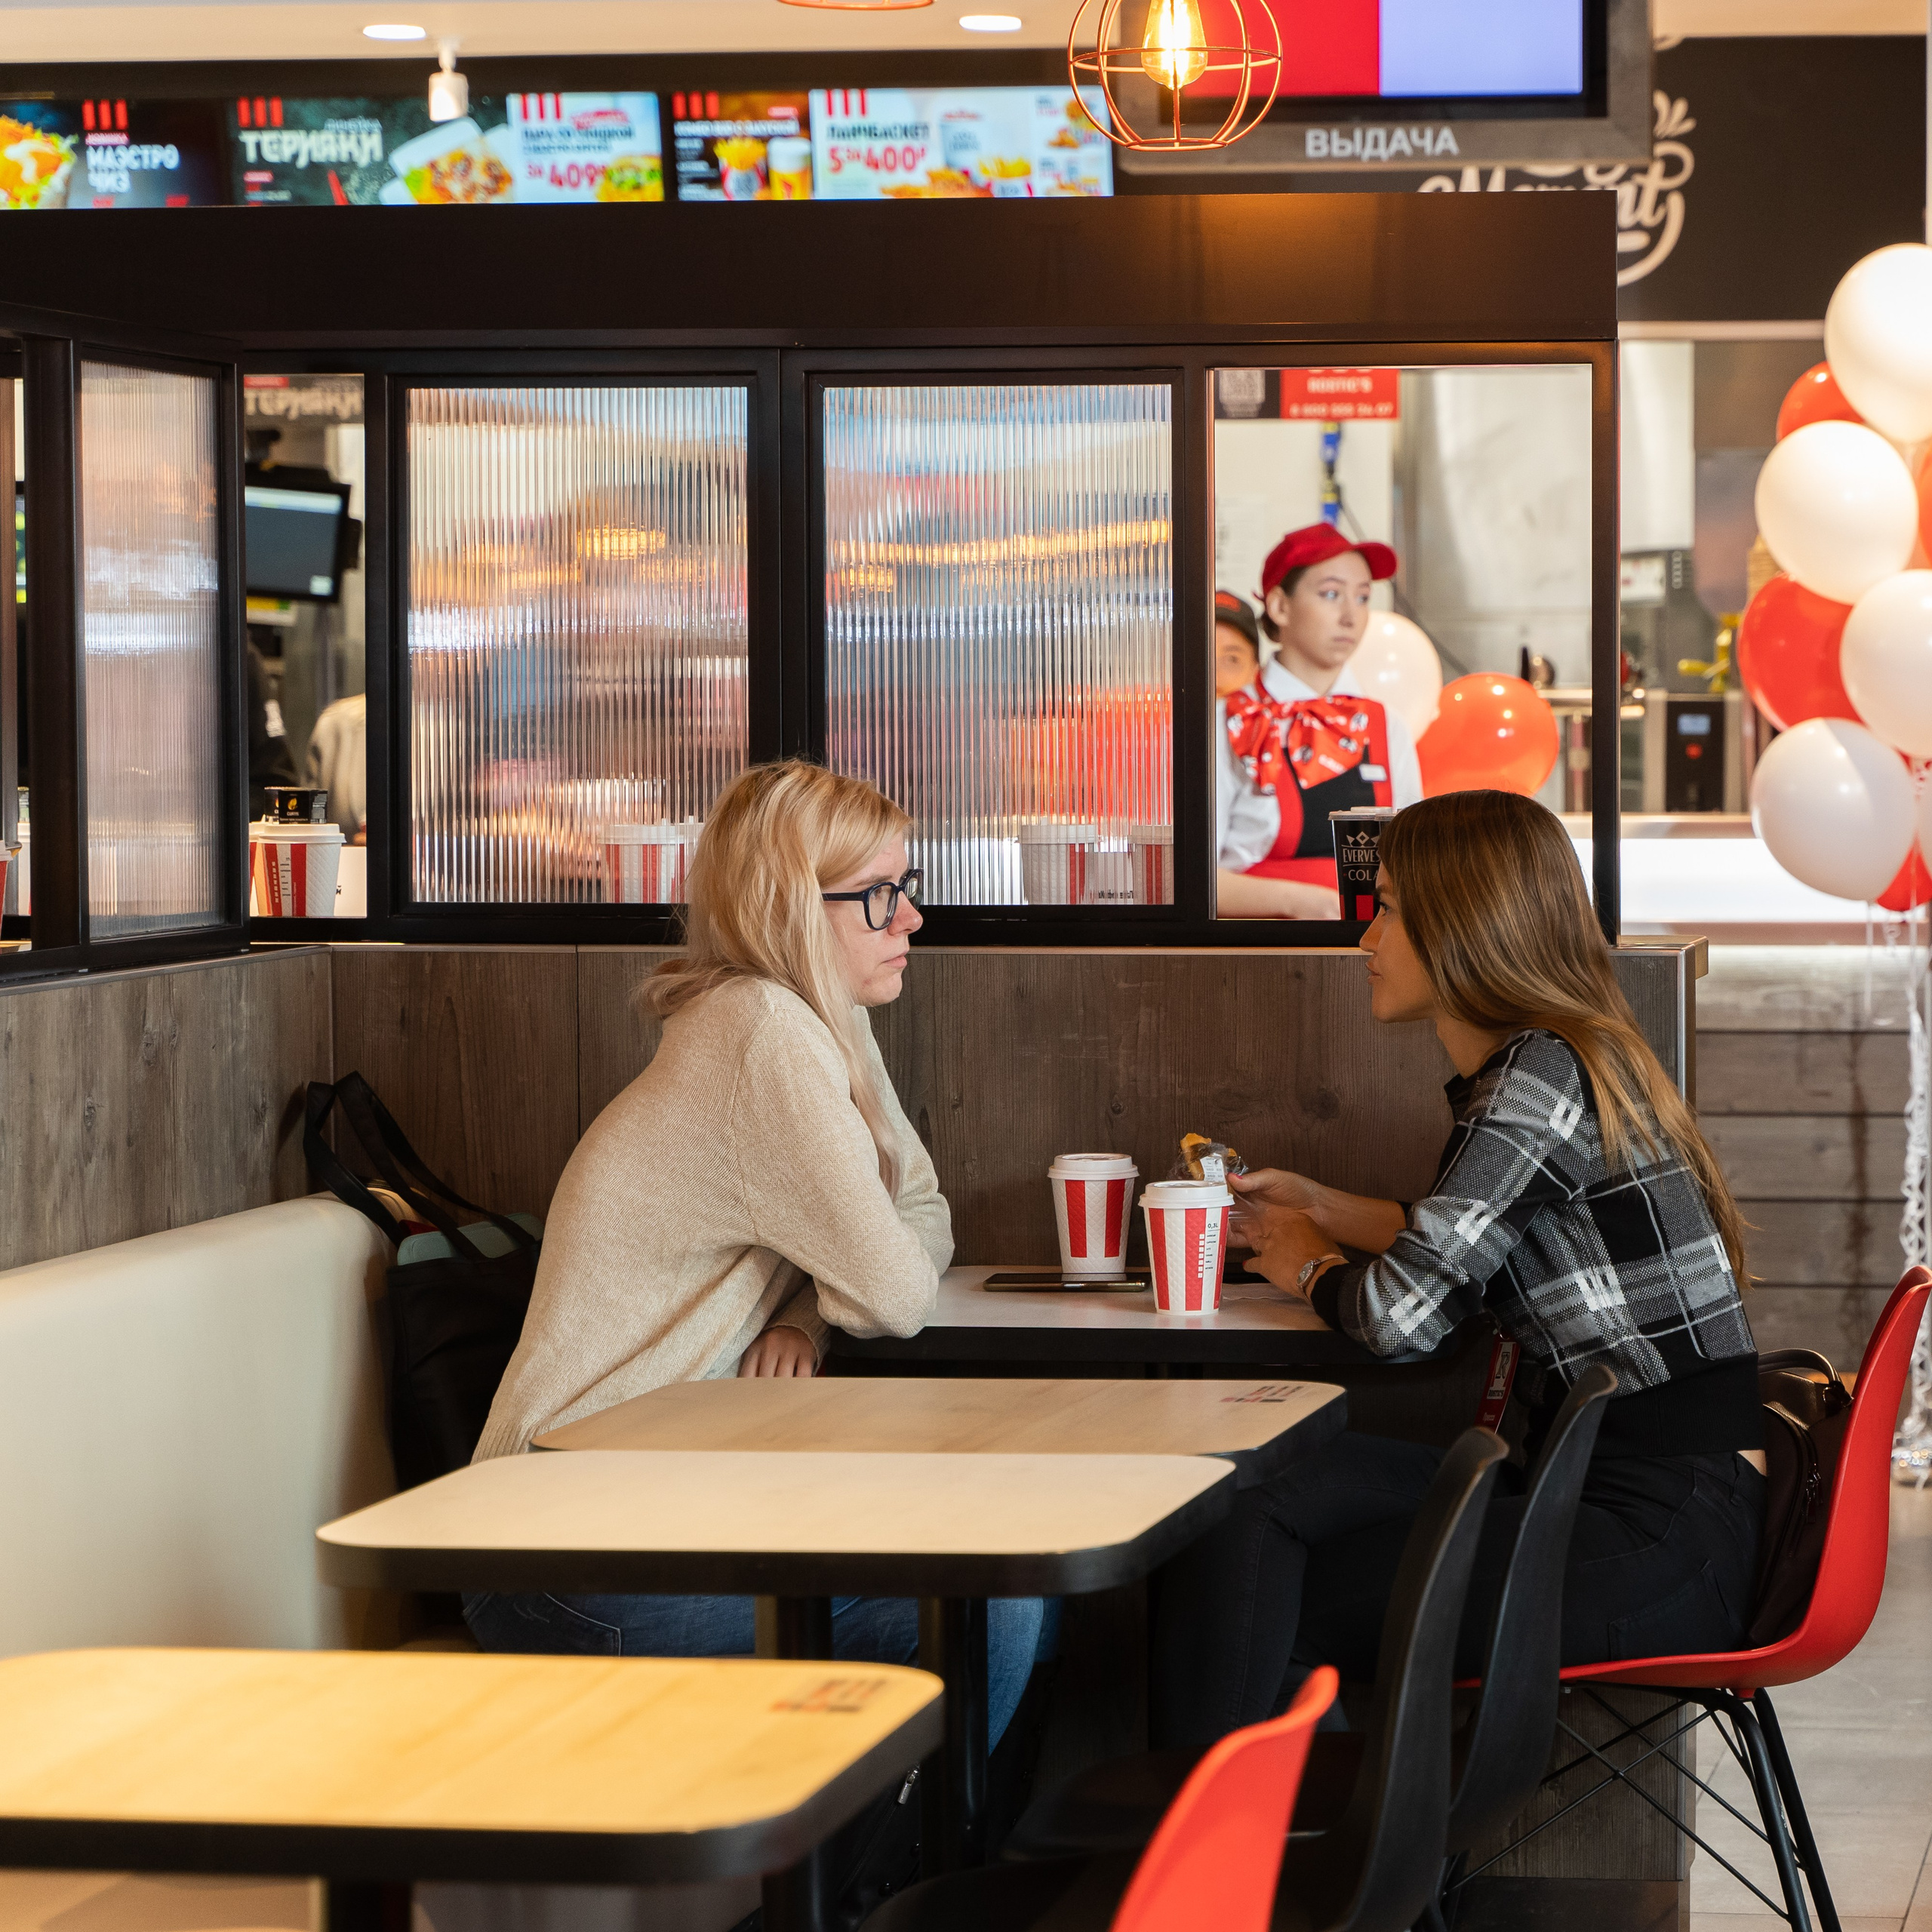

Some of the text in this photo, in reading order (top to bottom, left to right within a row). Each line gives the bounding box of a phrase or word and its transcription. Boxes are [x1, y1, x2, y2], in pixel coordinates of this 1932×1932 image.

[86, 144, 180, 171] МАЭСТРО
[238, 129, 383, 168] ТЕРИЯКИ
[1305, 126, 1460, 162] ВЫДАЧА
[87, 168, 132, 193] ЧИЗ
[1343, 848, 1381, 863] EVERVES
